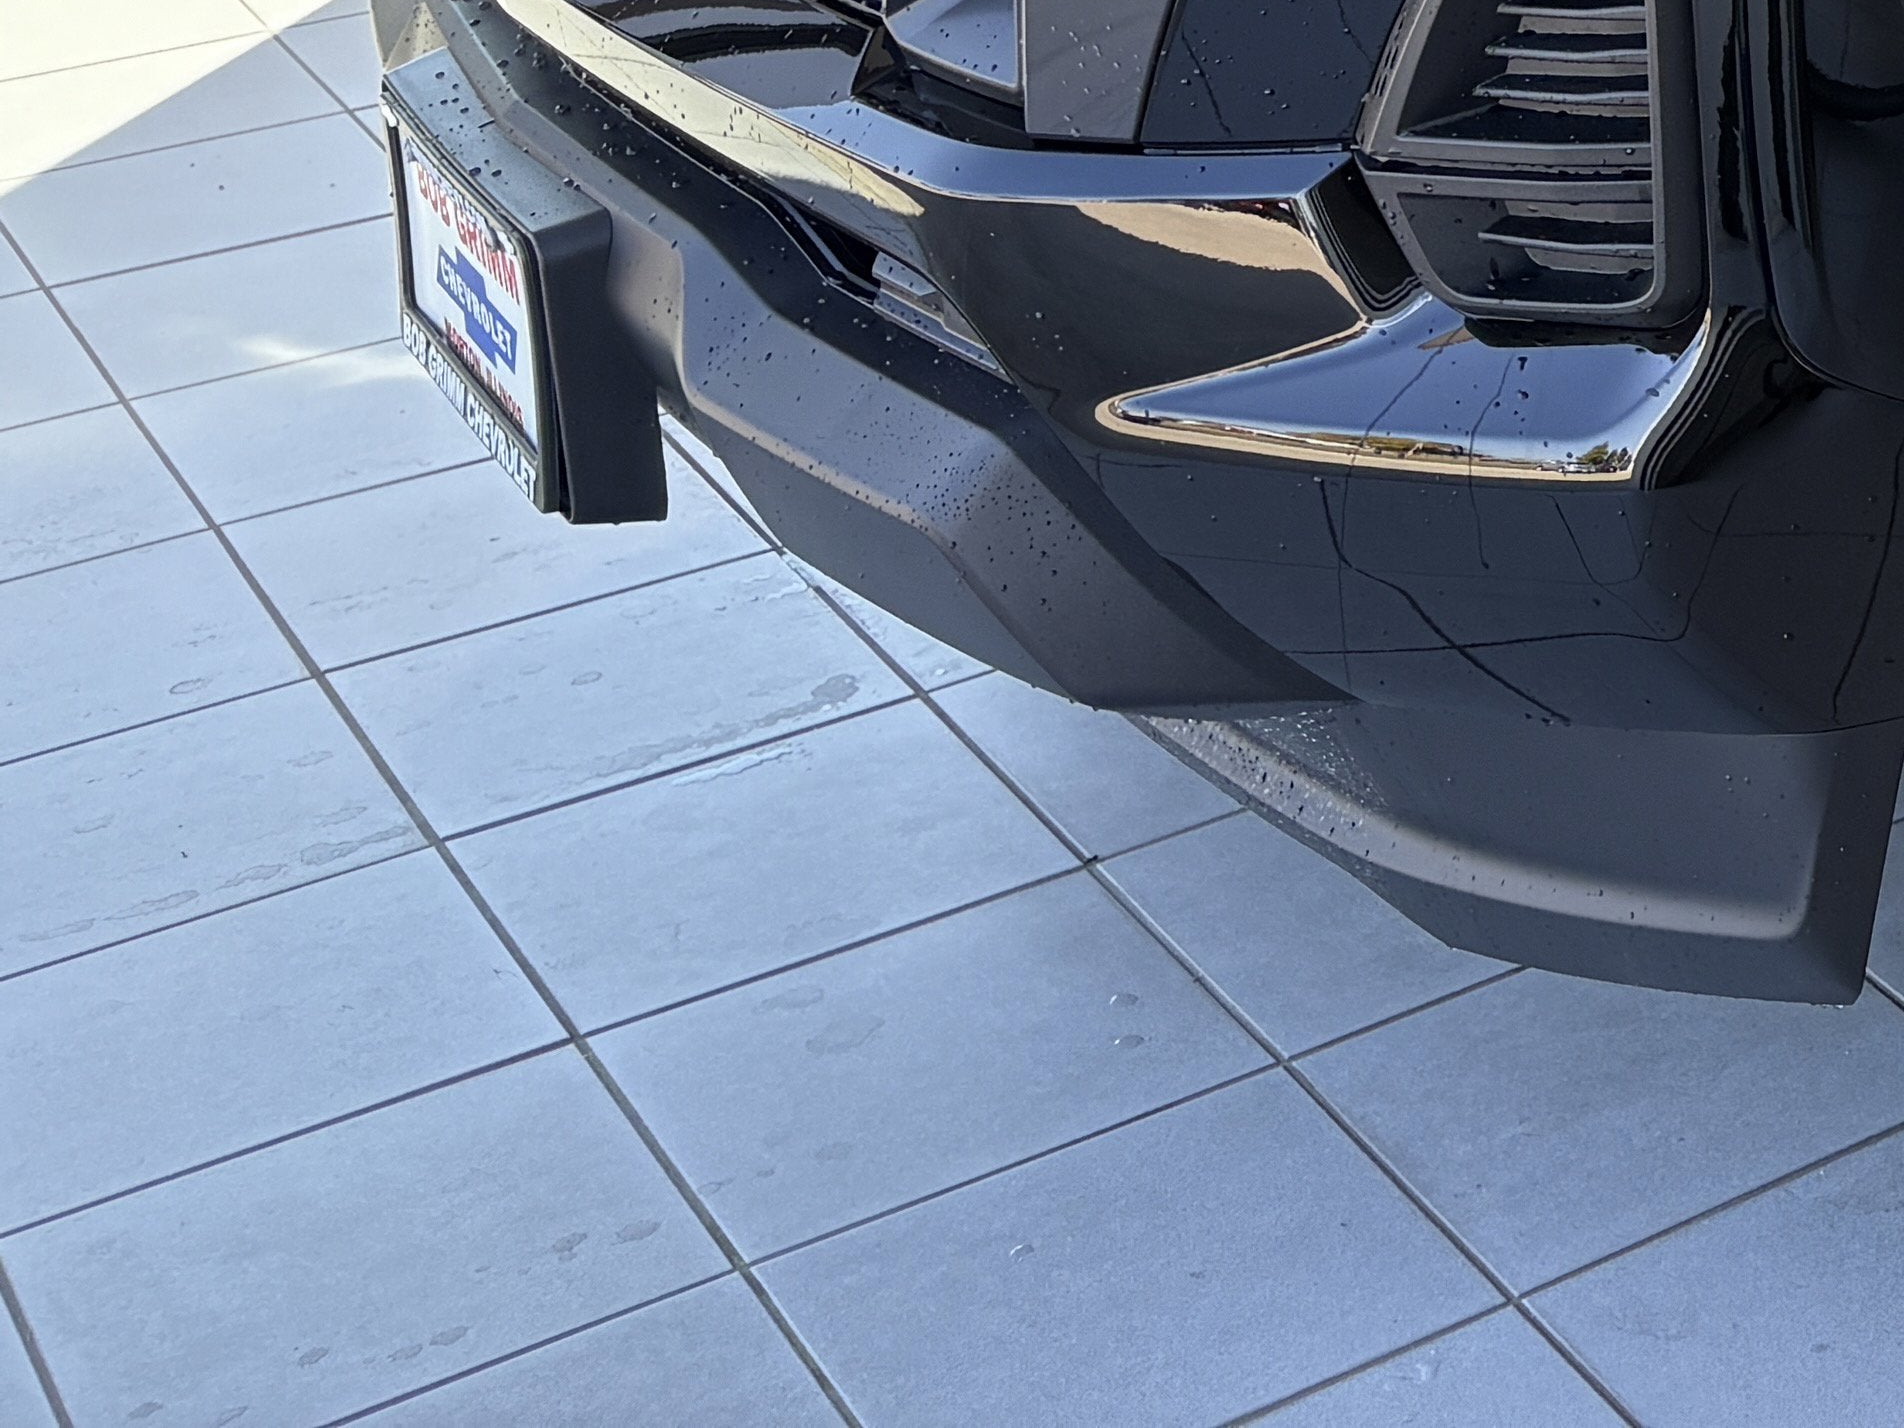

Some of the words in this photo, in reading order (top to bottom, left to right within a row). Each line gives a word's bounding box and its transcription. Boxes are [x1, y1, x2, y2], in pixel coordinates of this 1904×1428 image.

[417, 162, 450, 227] BOB
[454, 199, 520, 306] GRIMM
[440, 255, 512, 360] CHEVROLET
[403, 313, 428, 366] BOB
[428, 346, 466, 415] GRIMM
[466, 394, 537, 502] CHEVROLET
